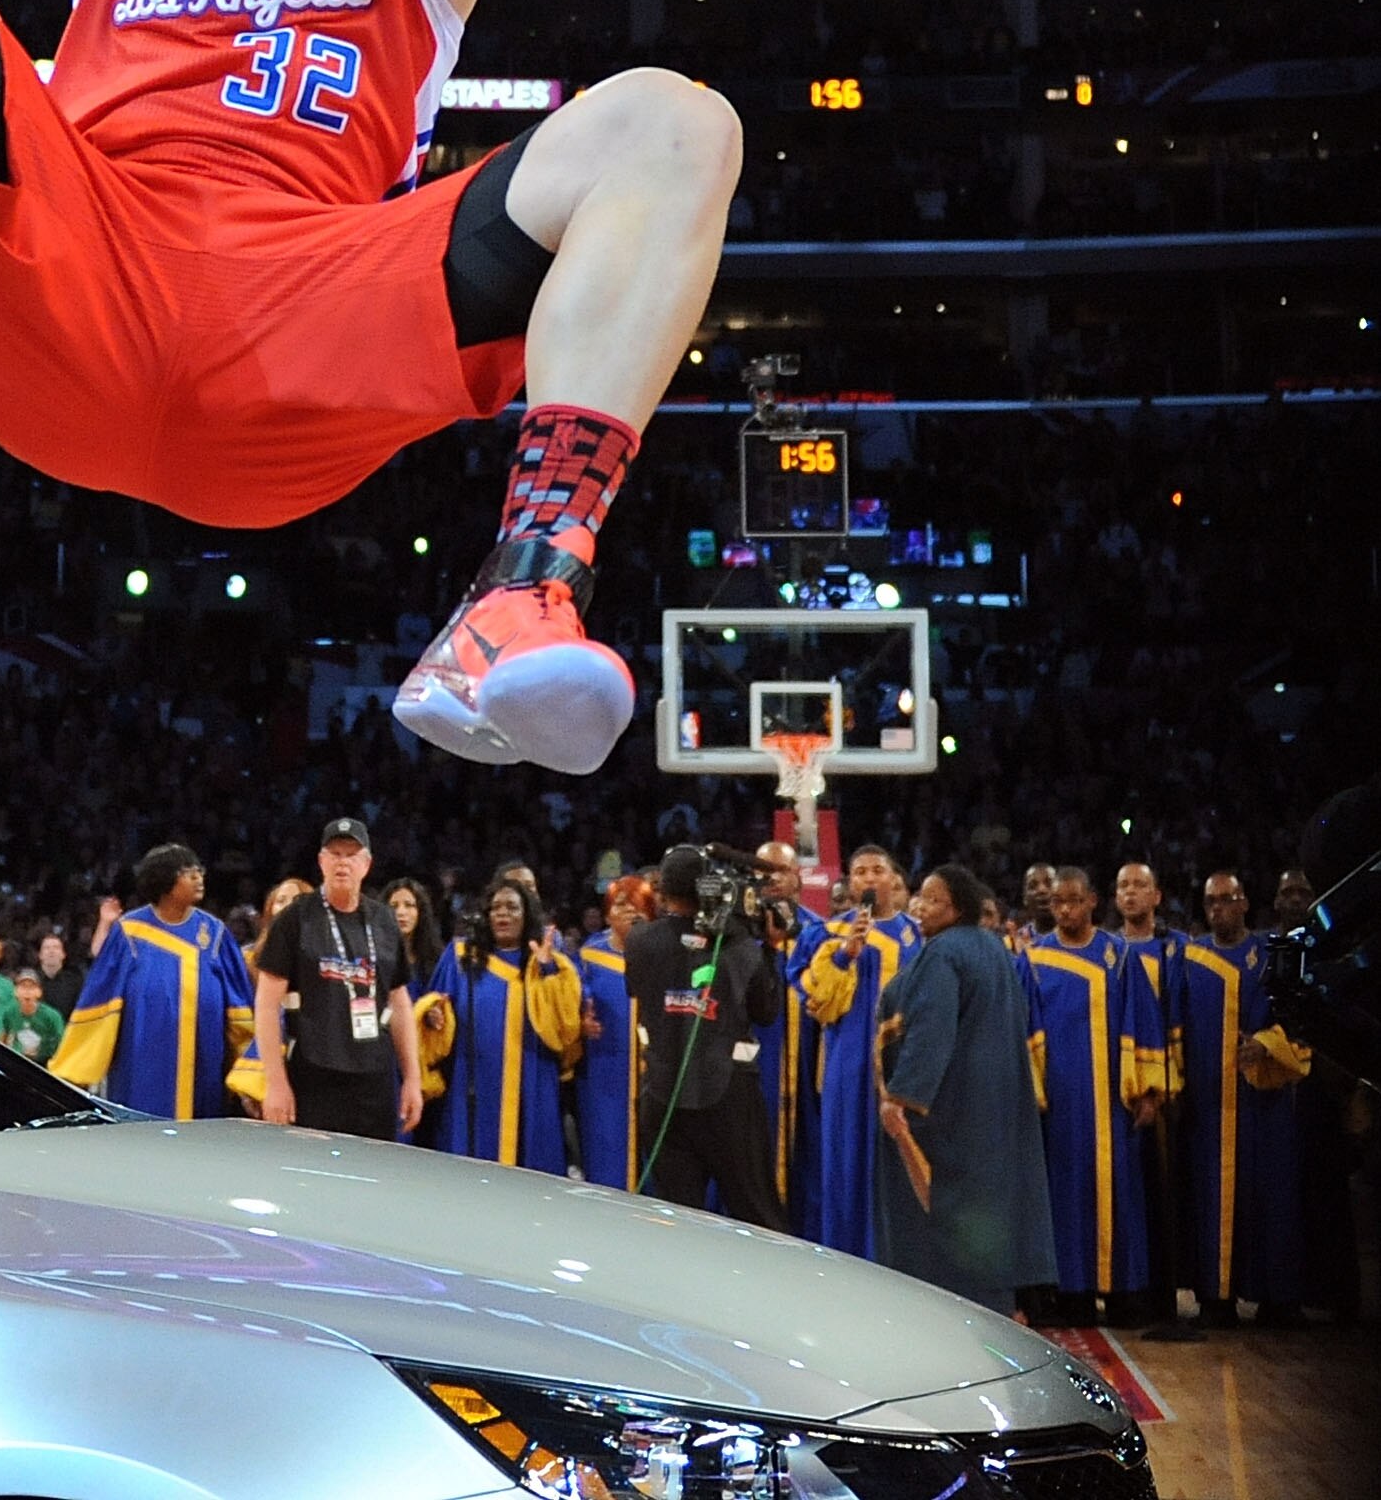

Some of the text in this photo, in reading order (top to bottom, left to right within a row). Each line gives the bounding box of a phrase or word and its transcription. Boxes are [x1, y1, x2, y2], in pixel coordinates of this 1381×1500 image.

[221, 27, 362, 134] 32
[440, 79, 551, 110] STAPLES
[811, 79, 862, 109] 1:56
[780, 441, 836, 473] 1:56
